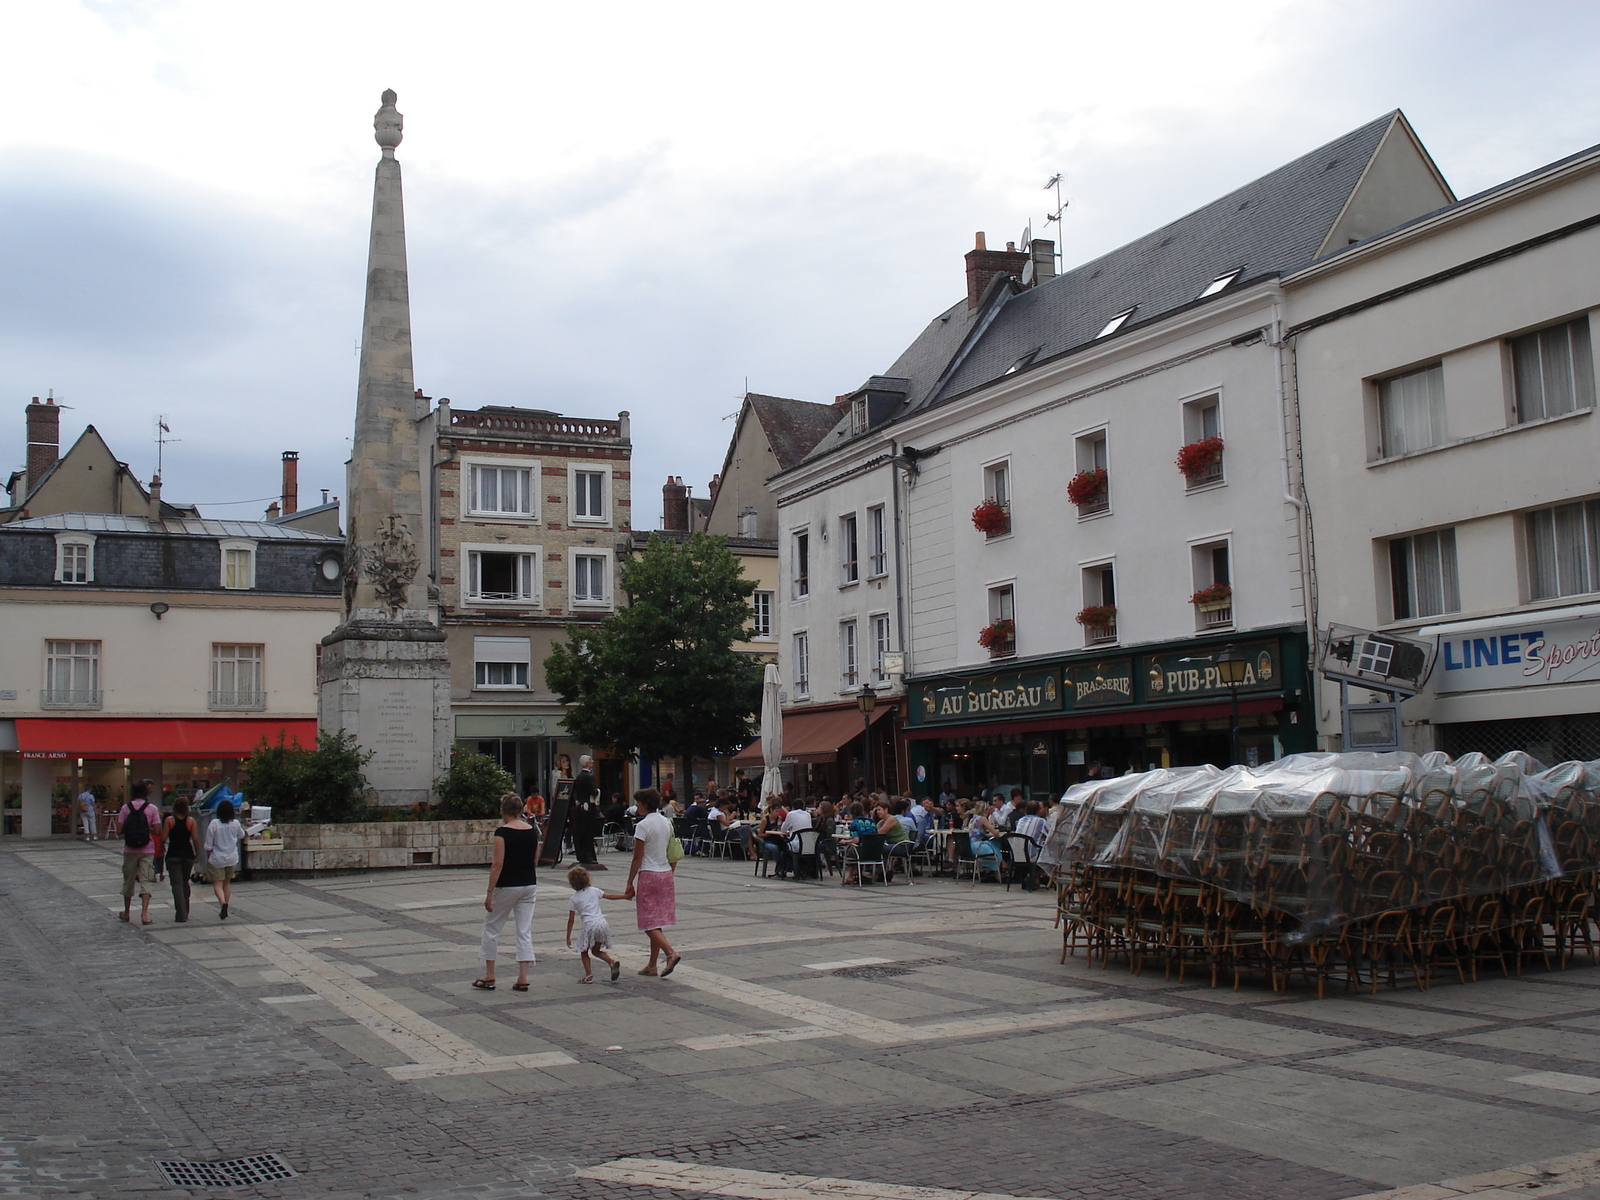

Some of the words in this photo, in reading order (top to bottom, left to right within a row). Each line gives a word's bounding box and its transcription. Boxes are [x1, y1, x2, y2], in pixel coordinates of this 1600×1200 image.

[1443, 630, 1544, 671] LINET
[1167, 662, 1257, 693] PUB-PIA
[940, 695, 964, 715] AU
[967, 687, 1042, 713] BUREAU
